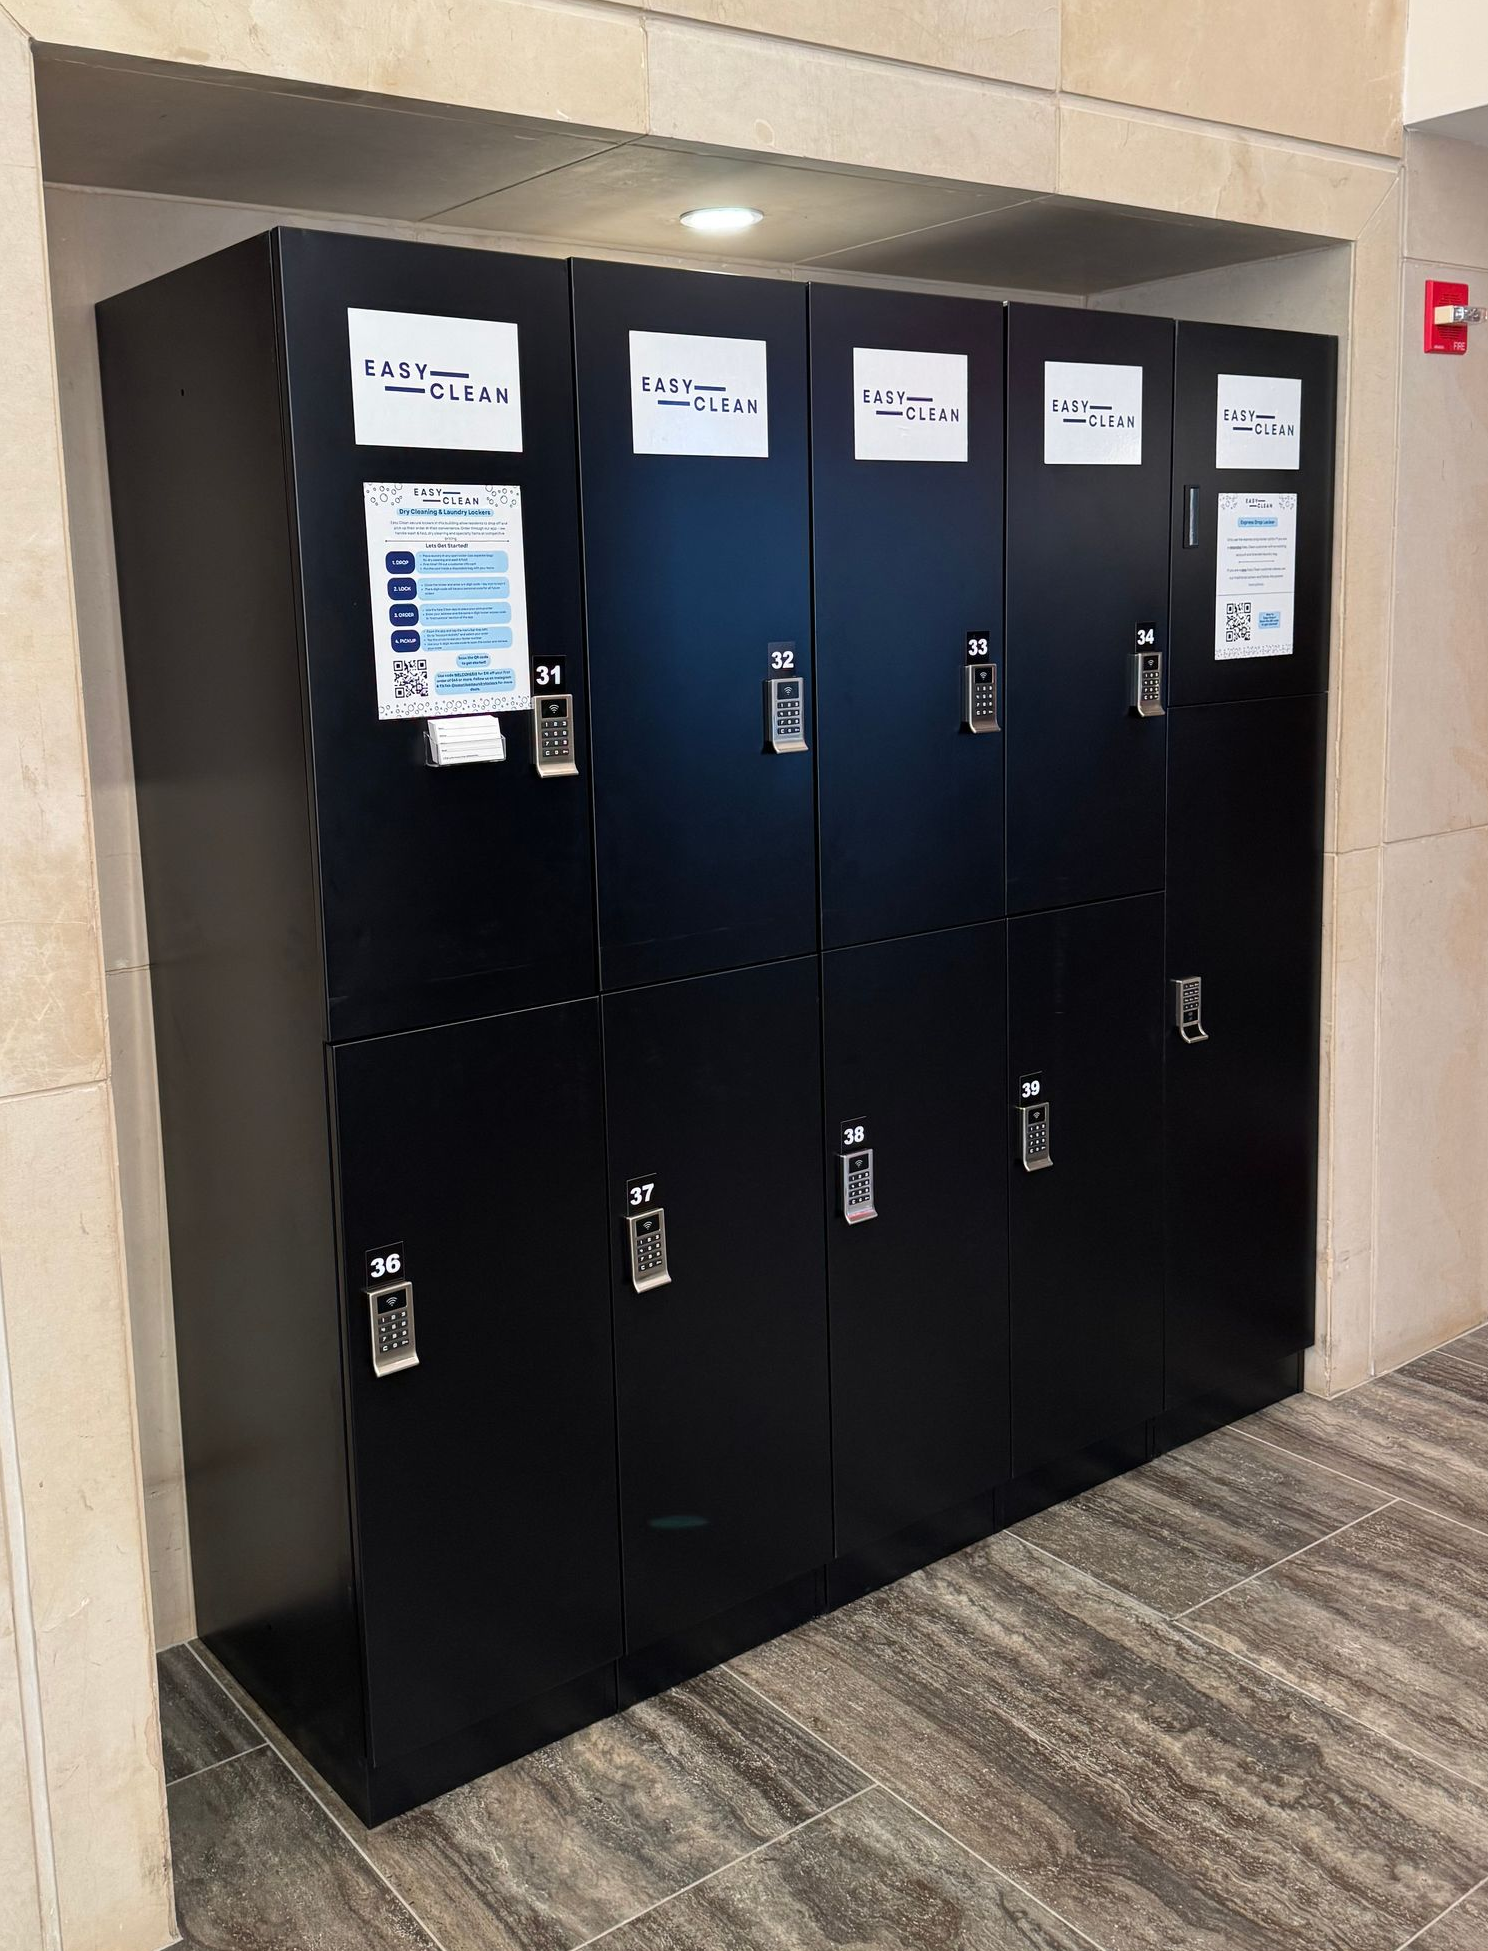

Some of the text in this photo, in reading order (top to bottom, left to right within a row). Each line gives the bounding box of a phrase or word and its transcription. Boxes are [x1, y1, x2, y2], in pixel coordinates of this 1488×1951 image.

[365, 360, 427, 380] EASY
[430, 383, 508, 403] CLEAN
[642, 377, 692, 394] EASY
[694, 397, 757, 413] CLEAN
[864, 390, 906, 404] EASY
[906, 407, 958, 422] CLEAN
[1053, 400, 1089, 412] EASY
[1089, 415, 1134, 428] CLEAN
[1224, 409, 1256, 422] EASY
[1256, 424, 1294, 436] CLEAN
[414, 488, 442, 497] EASY
[443, 497, 479, 505] CLEAN
[1137, 628, 1155, 646] 34
[969, 638, 988, 656] 33
[772, 651, 793, 669] 32
[537, 665, 560, 685] 31
[1021, 1080, 1041, 1098] 39
[843, 1125, 865, 1145] 38
[631, 1183, 654, 1205] 37
[371, 1254, 401, 1277] 36
